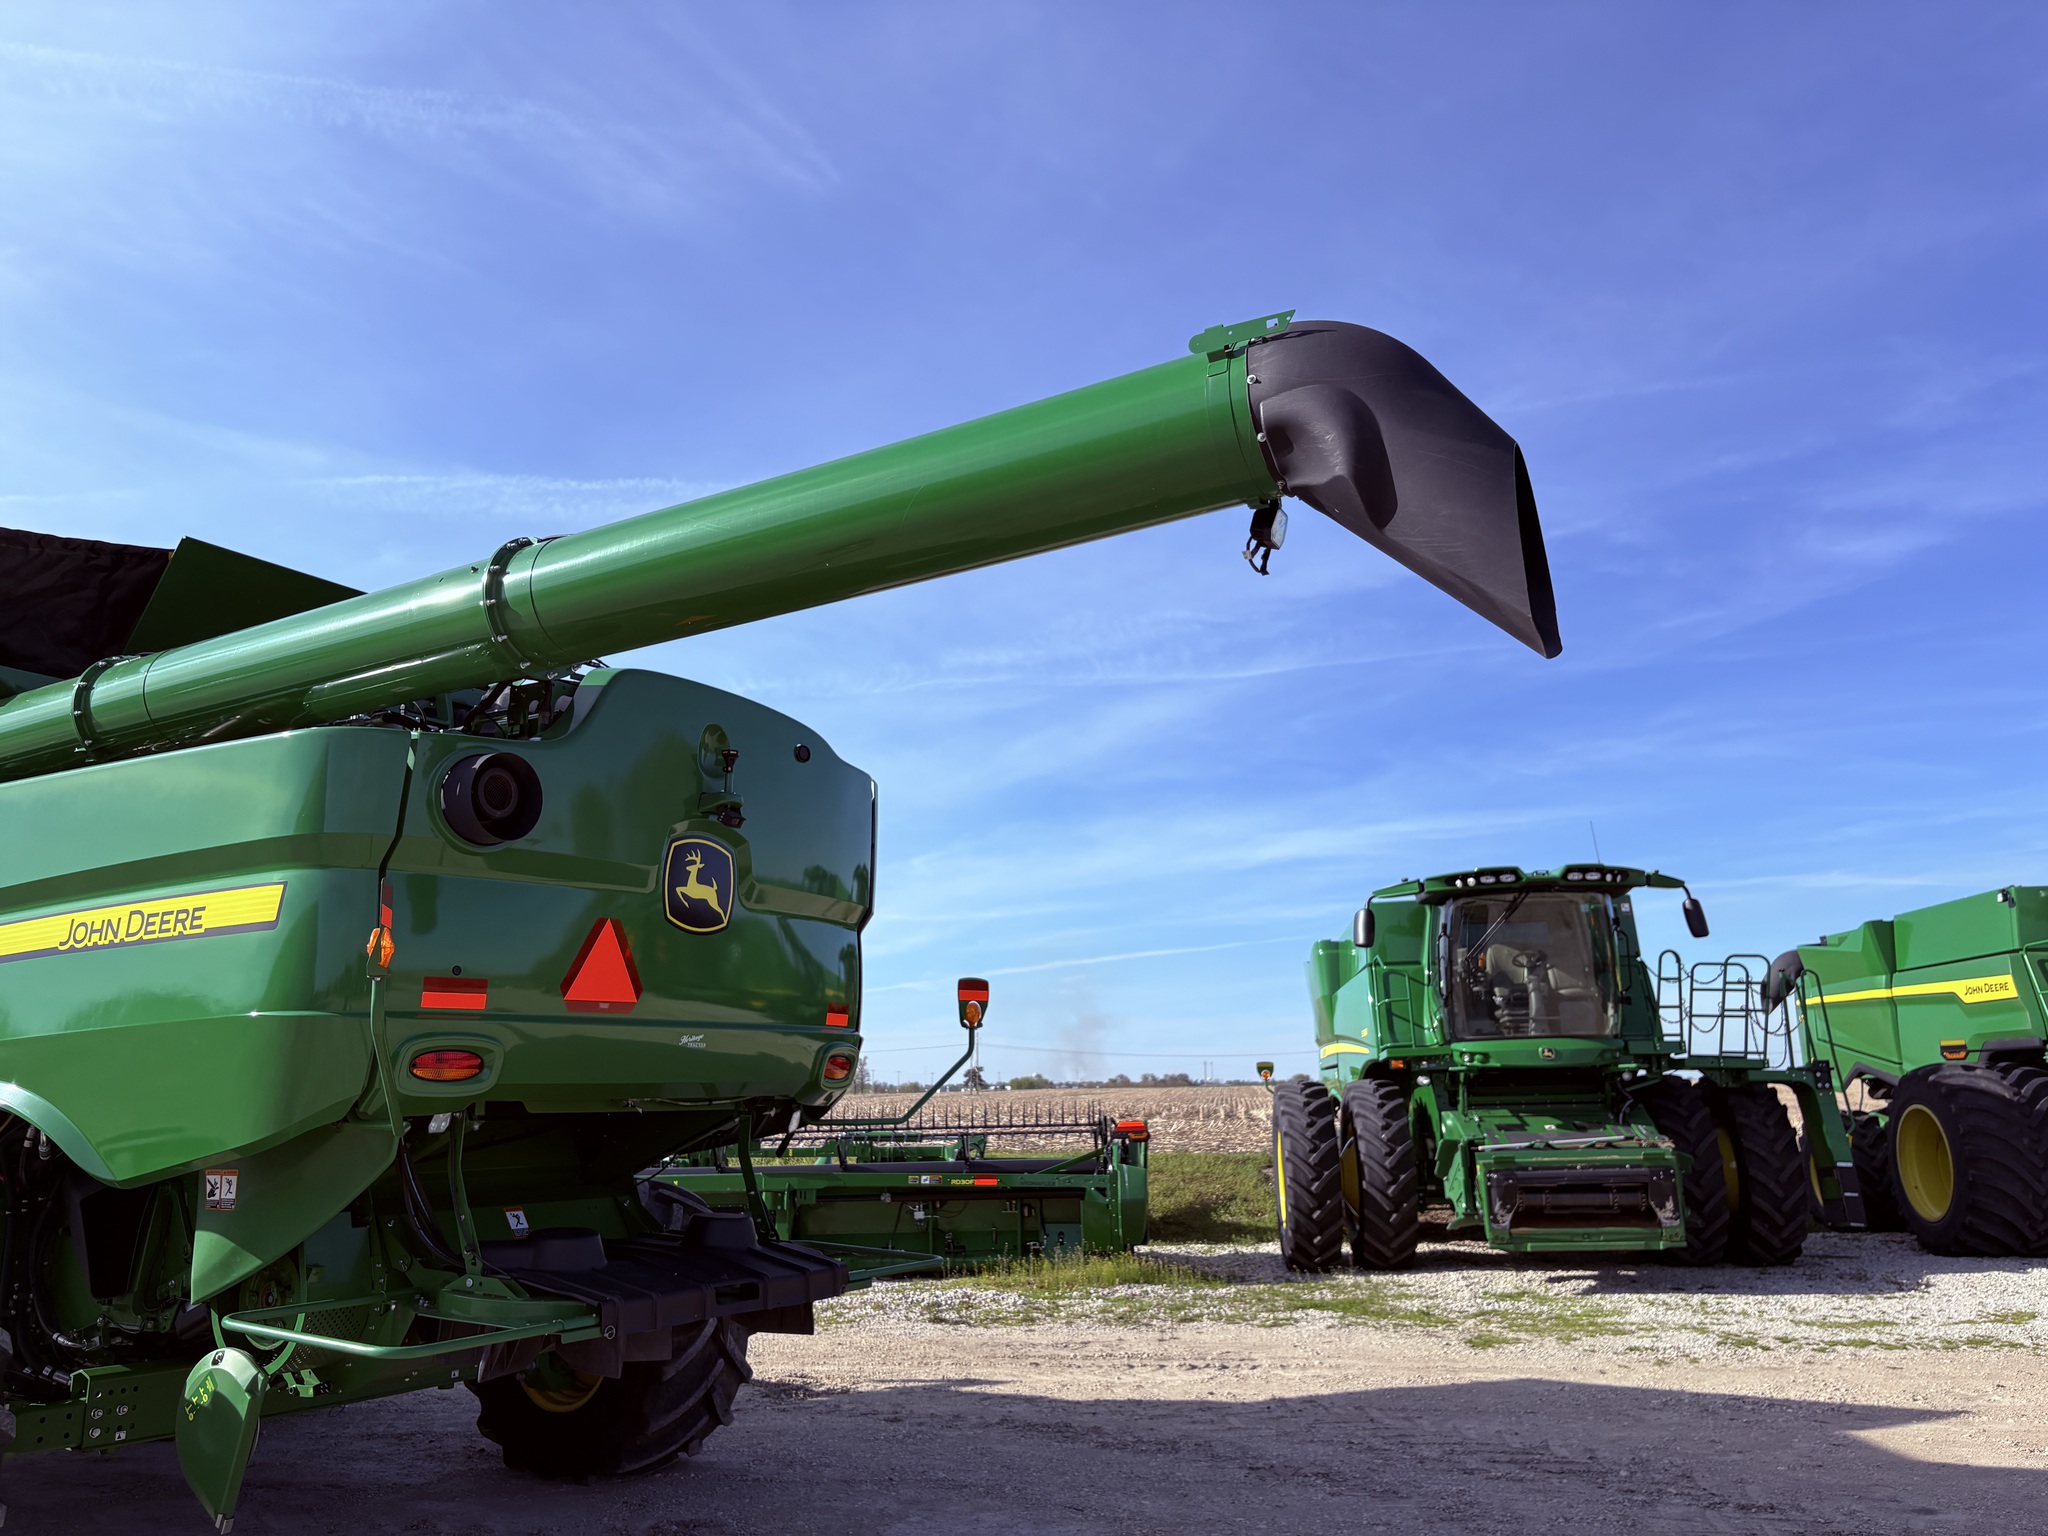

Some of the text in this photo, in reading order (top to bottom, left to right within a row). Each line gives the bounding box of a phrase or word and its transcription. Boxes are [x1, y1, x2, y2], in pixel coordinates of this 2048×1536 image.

[58, 906, 206, 947] JOHN DEERE
[1964, 982, 2010, 995] JOHN DEERE
